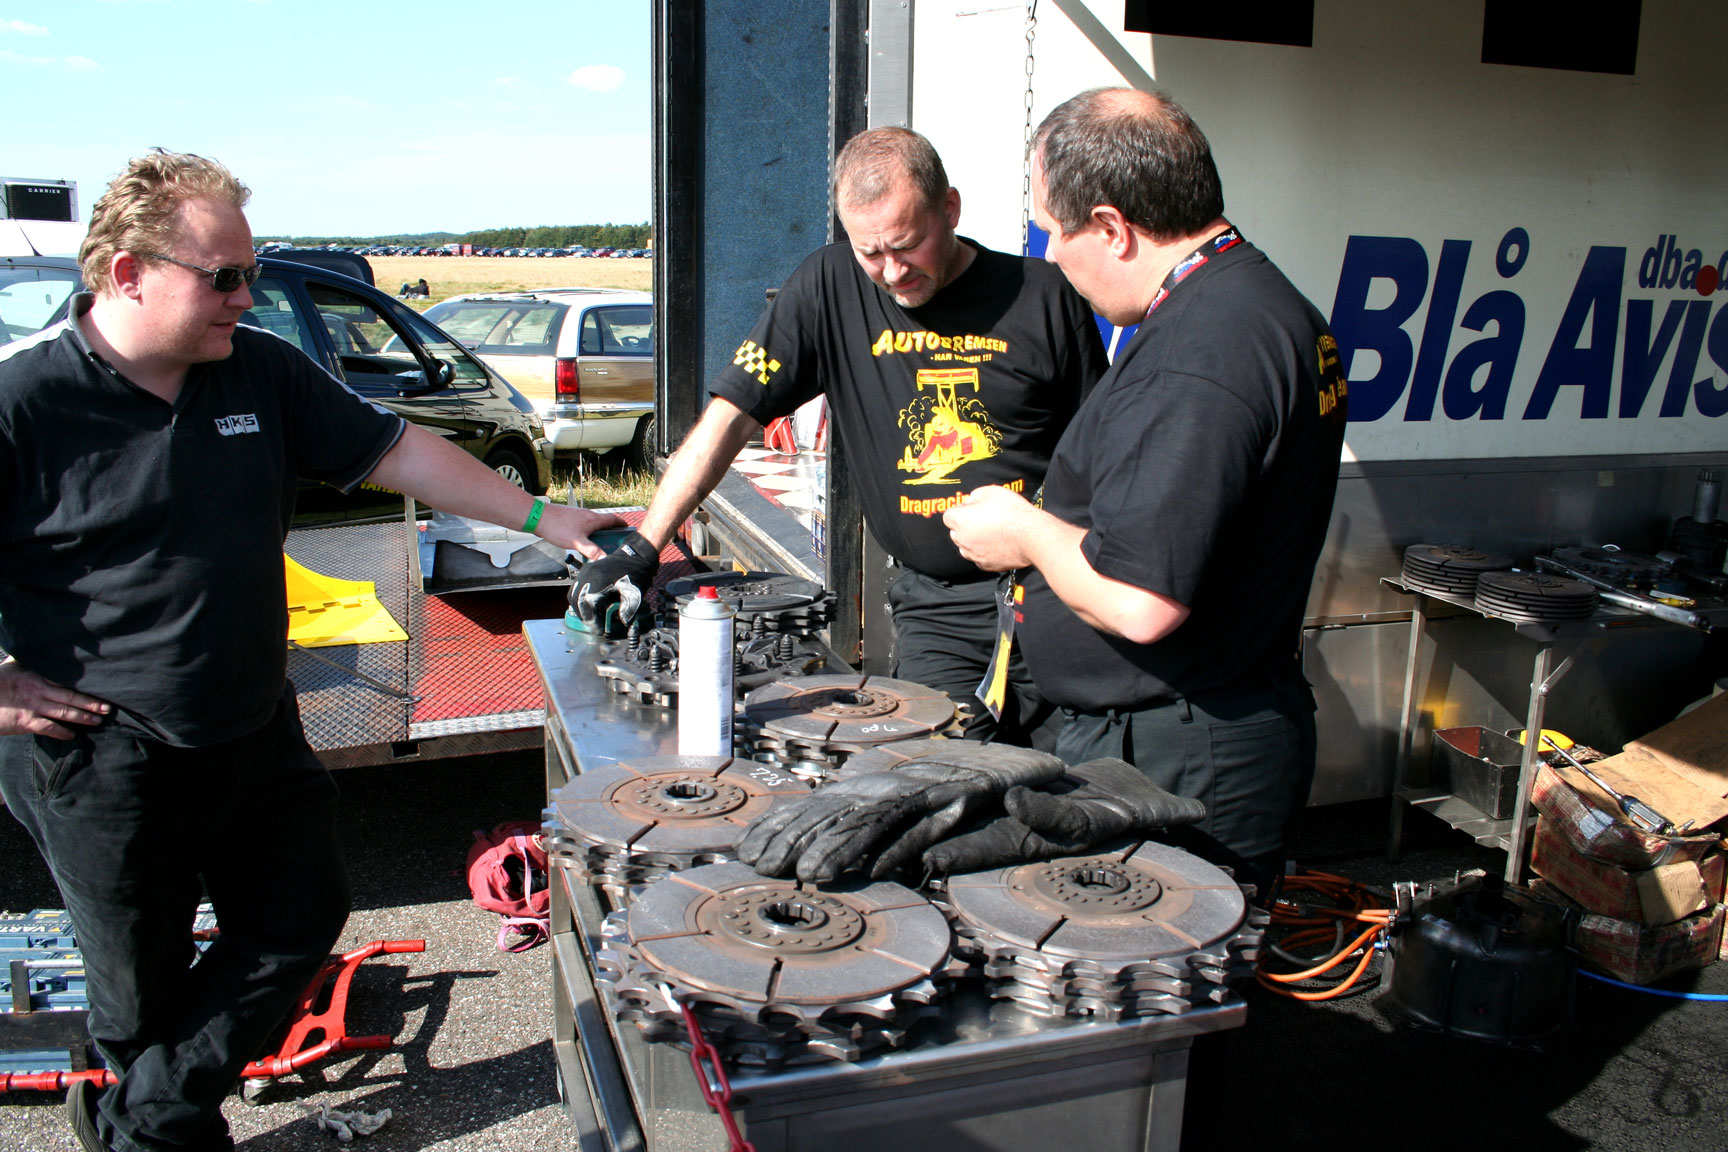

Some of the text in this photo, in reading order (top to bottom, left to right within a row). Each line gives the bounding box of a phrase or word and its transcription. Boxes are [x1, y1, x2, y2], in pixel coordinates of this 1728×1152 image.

[1328, 226, 1728, 423] Blå Avis
[215, 414, 258, 431] HKS
